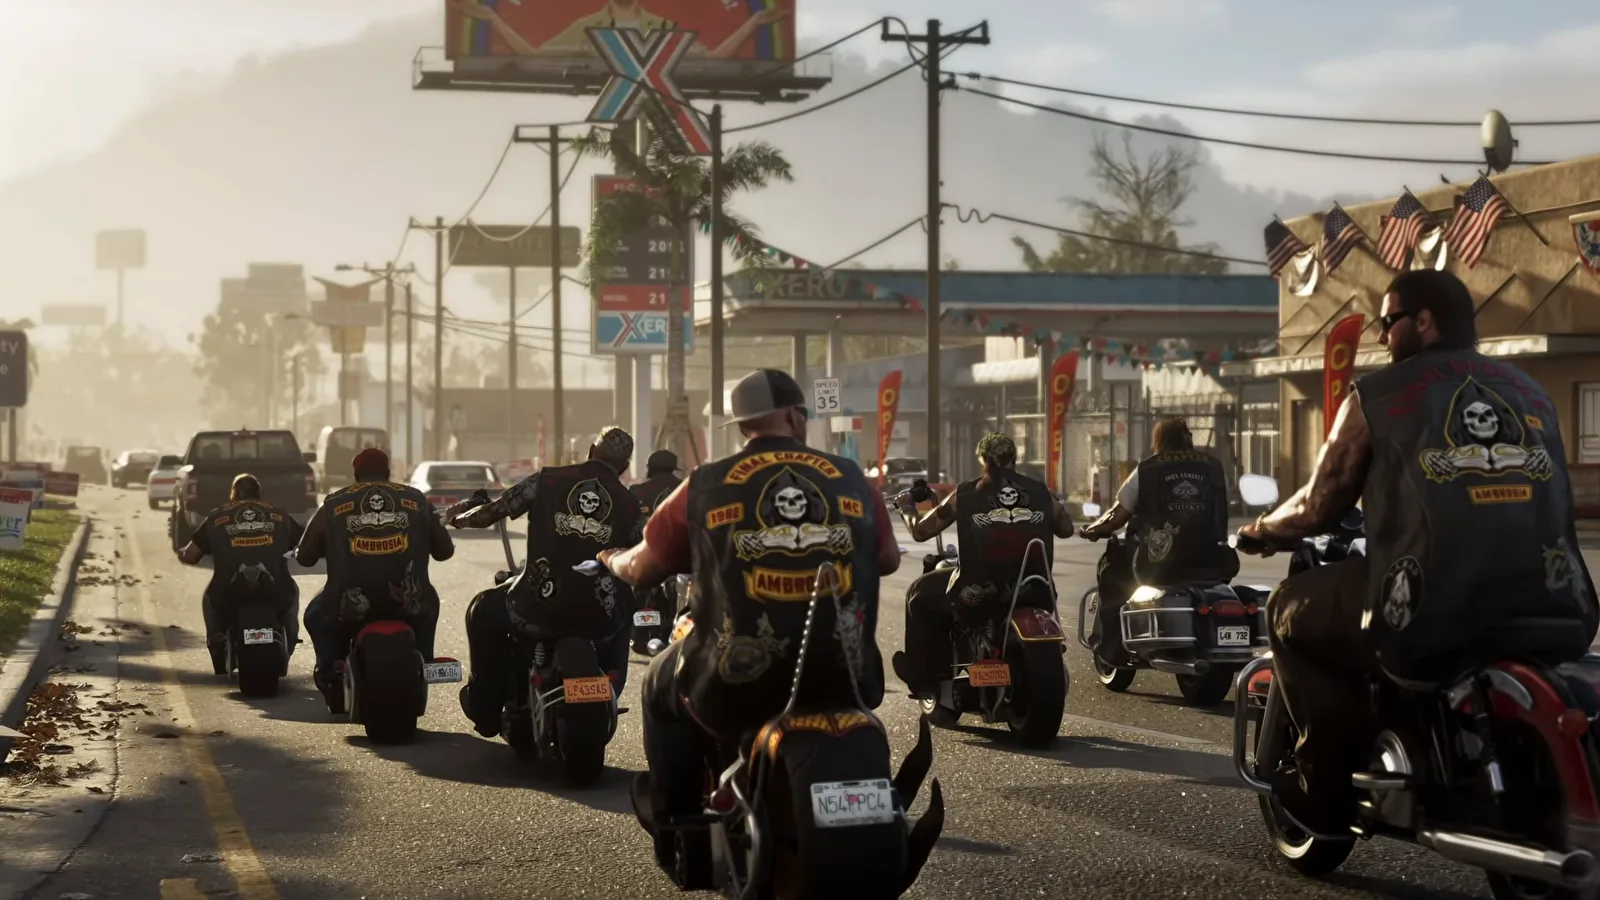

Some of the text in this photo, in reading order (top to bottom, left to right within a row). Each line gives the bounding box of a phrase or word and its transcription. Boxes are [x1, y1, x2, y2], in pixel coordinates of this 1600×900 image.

[612, 312, 667, 347] XER
[816, 381, 837, 389] SPEED
[817, 395, 838, 410] 35
[729, 452, 837, 481] FINAL CHAPTER
[842, 499, 860, 514] MC
[355, 537, 402, 551] AMBROSIA
[1236, 631, 1248, 640] 732
